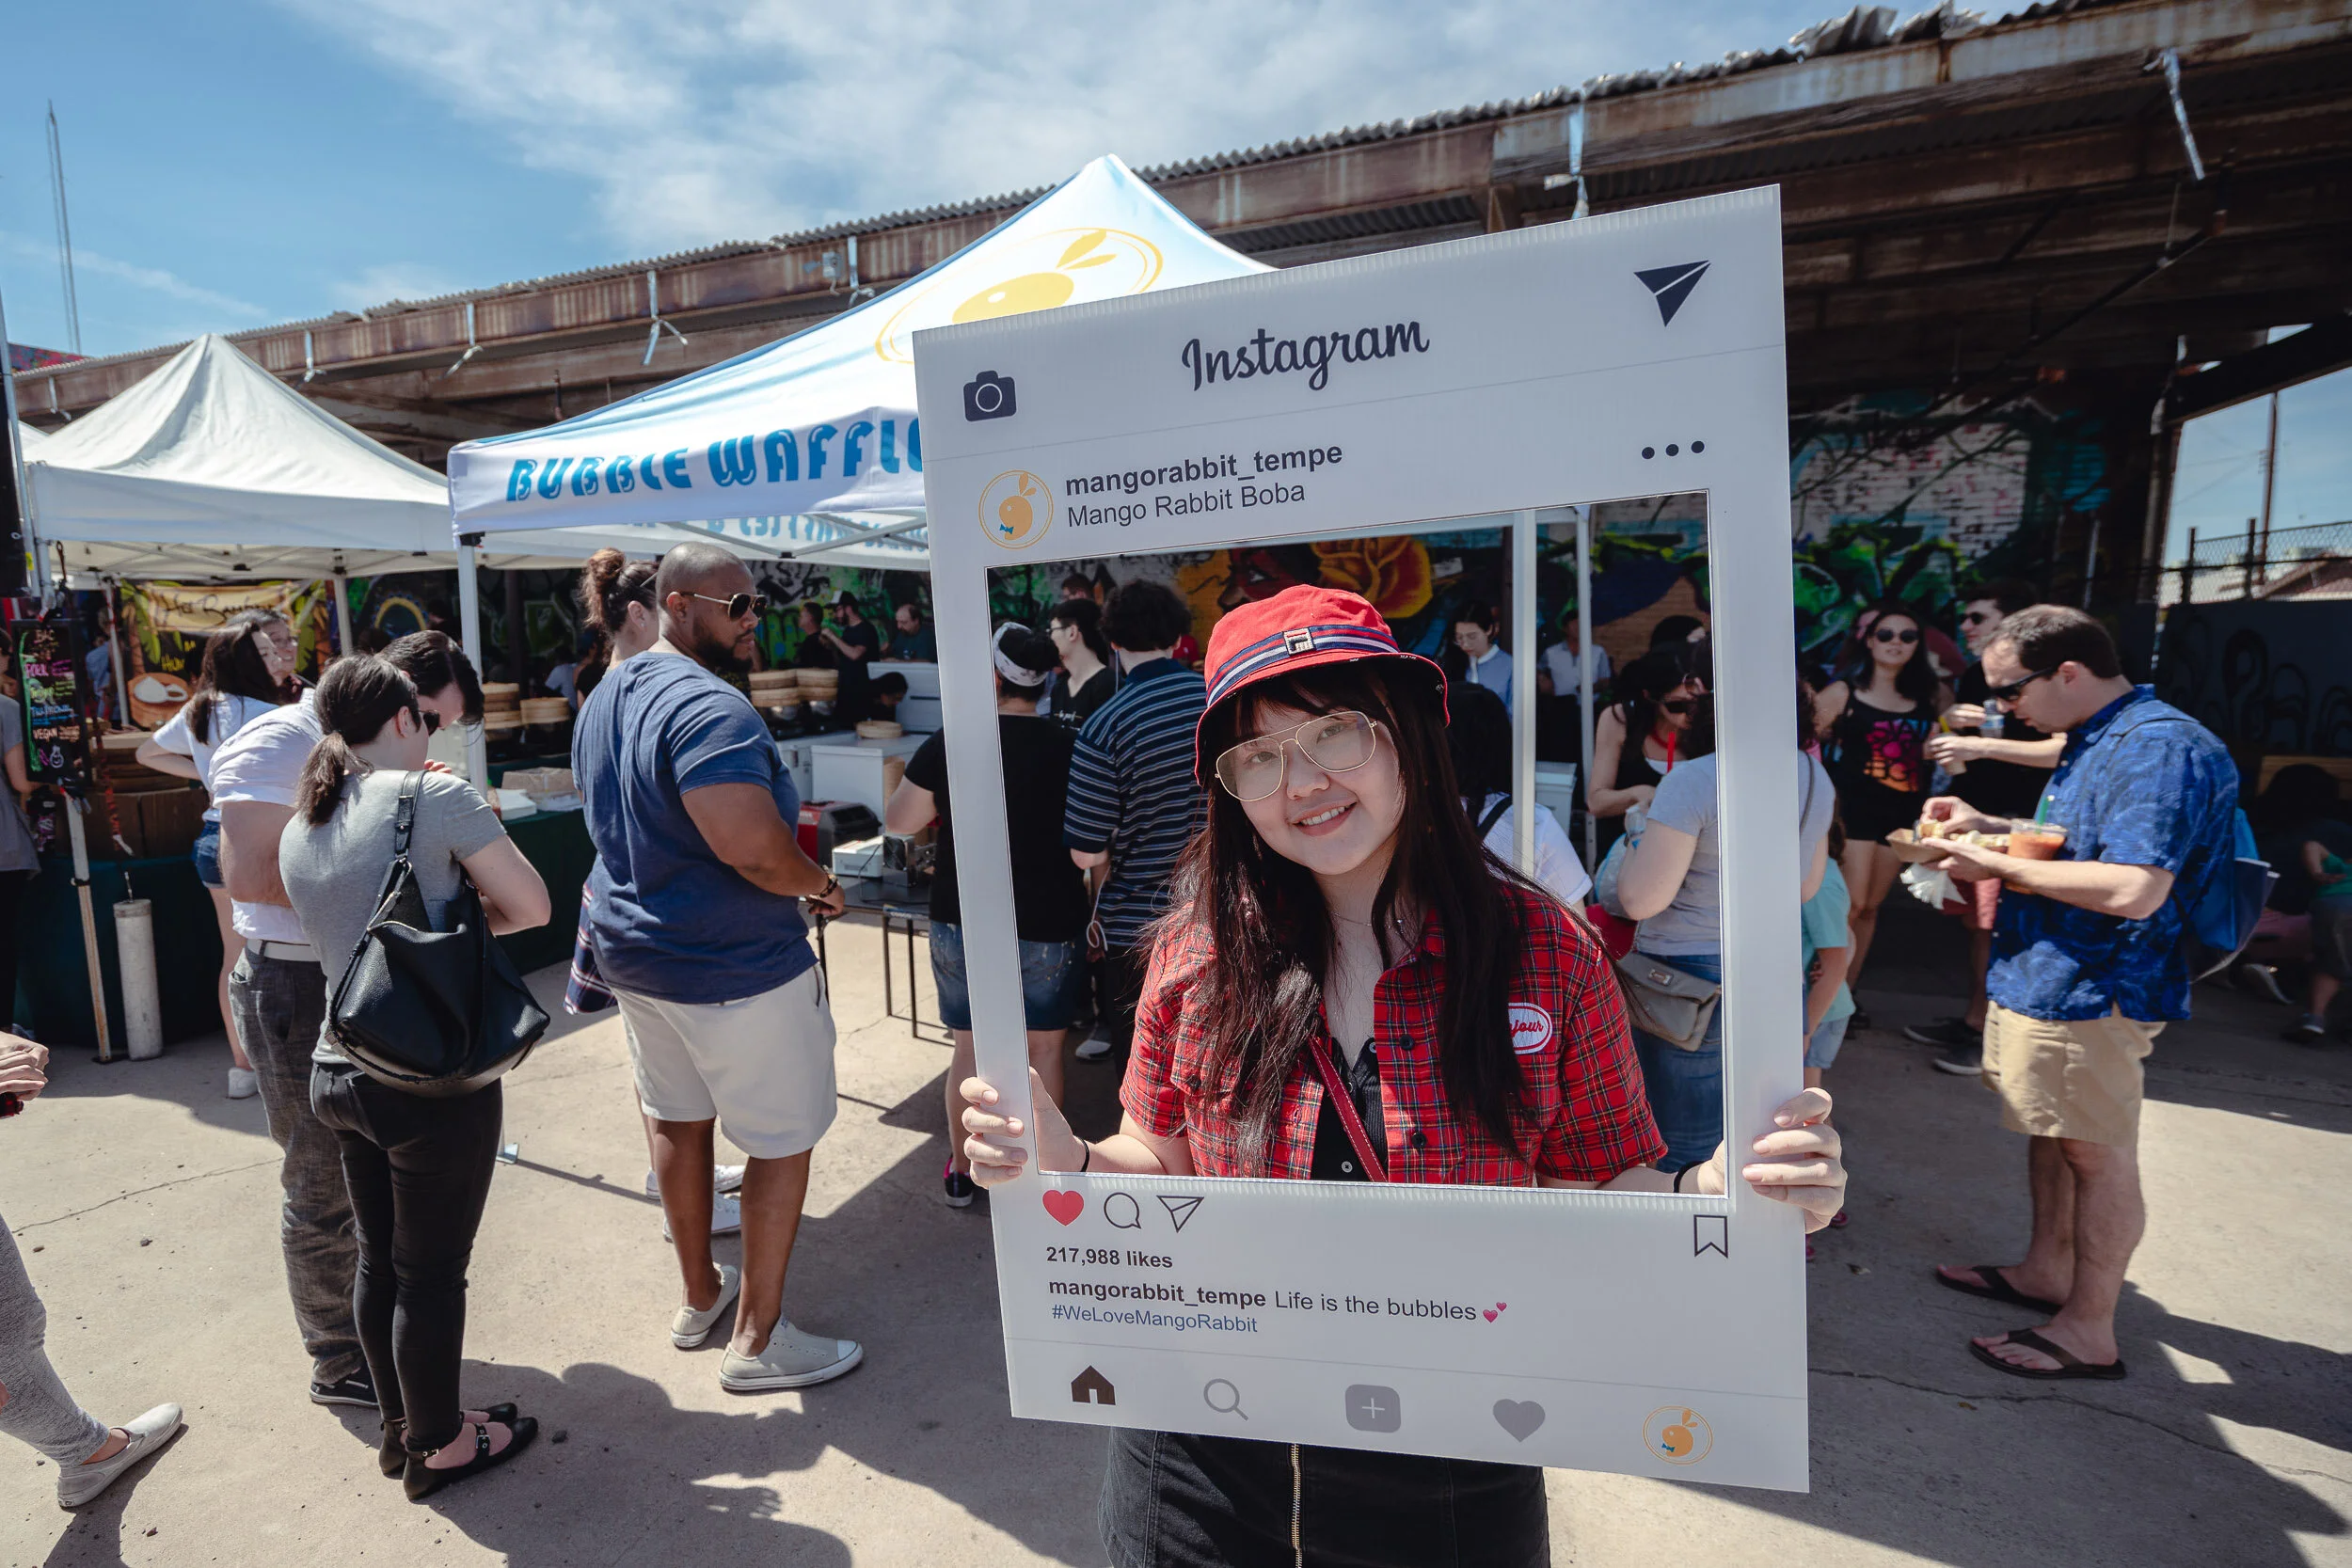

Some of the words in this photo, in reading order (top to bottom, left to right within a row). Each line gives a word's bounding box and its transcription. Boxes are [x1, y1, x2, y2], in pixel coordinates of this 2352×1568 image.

[1182, 321, 1430, 391] Instagram
[506, 448, 692, 501] BUBBLE
[1066, 445, 1343, 496] mangorabbit_tempe
[1068, 499, 1147, 528] Mango
[1155, 488, 1233, 517] Rabbit
[1241, 482, 1306, 508] Boba
[1046, 1246, 1120, 1266] 217,988
[1126, 1250, 1173, 1268] likes
[1049, 1281, 1266, 1309] mangorabbit_tempe
[1275, 1291, 1313, 1310] Life
[1321, 1293, 1338, 1311] is
[1345, 1295, 1379, 1314] the
[1388, 1297, 1477, 1321] bubbles
[1052, 1304, 1258, 1333] #WeLoveMangoRabbit
